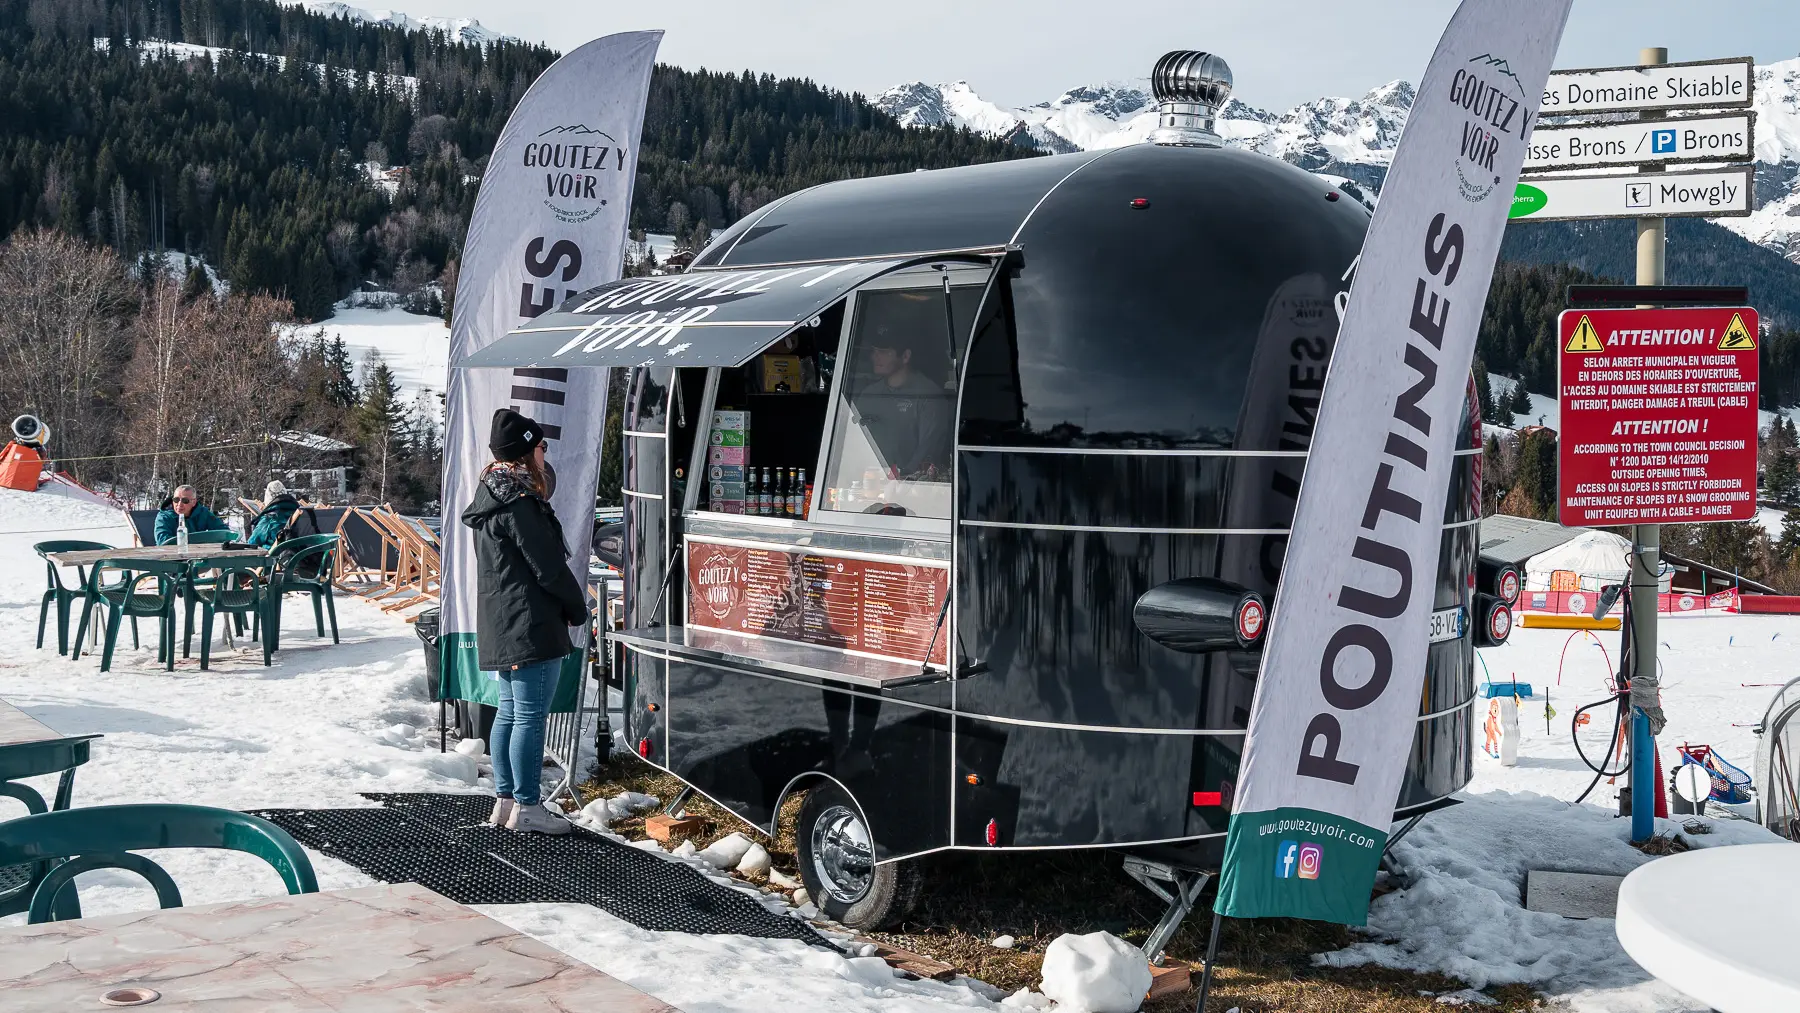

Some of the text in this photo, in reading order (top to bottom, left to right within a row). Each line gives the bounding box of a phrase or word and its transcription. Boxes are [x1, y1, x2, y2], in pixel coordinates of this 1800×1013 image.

[1568, 83, 1659, 105] Domaine
[1667, 74, 1743, 99] Skiable
[1450, 68, 1534, 141] GOUTEZ Y
[1525, 142, 1561, 160] isse
[1569, 136, 1626, 156] Brons
[1657, 132, 1672, 151] P
[1684, 129, 1743, 150] Brons
[523, 142, 628, 172] GOUTEZ Y
[1660, 180, 1738, 206] Mowgly
[1607, 329, 1704, 346] ATTENTION
[1584, 355, 1735, 368] SELON ARRETE MUNICIPAL EN VIGUEUR
[1578, 372, 1589, 382] EN
[1591, 371, 1623, 381] DEHORS
[1626, 371, 1641, 381] DES
[1643, 370, 1683, 380] HORAIRES
[1598, 385, 1609, 396] AU
[1611, 384, 1647, 395] DOMAINE
[1649, 383, 1683, 395] SKIABLE
[1684, 383, 1699, 394] EST
[1701, 382, 1756, 393] STRICTEMENT
[1612, 398, 1644, 410] DANGER
[1646, 397, 1678, 409] DAMAGE
[1680, 397, 1686, 409] A
[1688, 397, 1715, 409] TREUIL
[1717, 396, 1748, 408] (CABLE)
[1612, 419, 1698, 435] ATTENTION
[1574, 440, 1745, 454] ACCORDING TO THE TOWN COUNCIL DECISION
[1621, 456, 1639, 466] 1200
[1641, 455, 1666, 466] DATED
[1668, 454, 1709, 465] 14/12/2010
[1611, 468, 1645, 479] OUTSIDE
[1647, 467, 1680, 478] OPENING
[1576, 479, 1741, 493] ACCESS ON SLOPES IS STRICTLY FORBIDDEN
[1296, 212, 1465, 787] POUTINES
[1567, 492, 1750, 507] MAINTENANCE OF SLOPES BY A SNOW GROOMING
[1585, 509, 1603, 519] UNIT
[1605, 508, 1638, 519] EQUIPED
[1640, 507, 1660, 518] WITH
[1662, 507, 1667, 517] A
[1669, 506, 1693, 517] CABLE
[1701, 505, 1732, 516] DANGER
[698, 566, 739, 585] GOUTEZ Y
